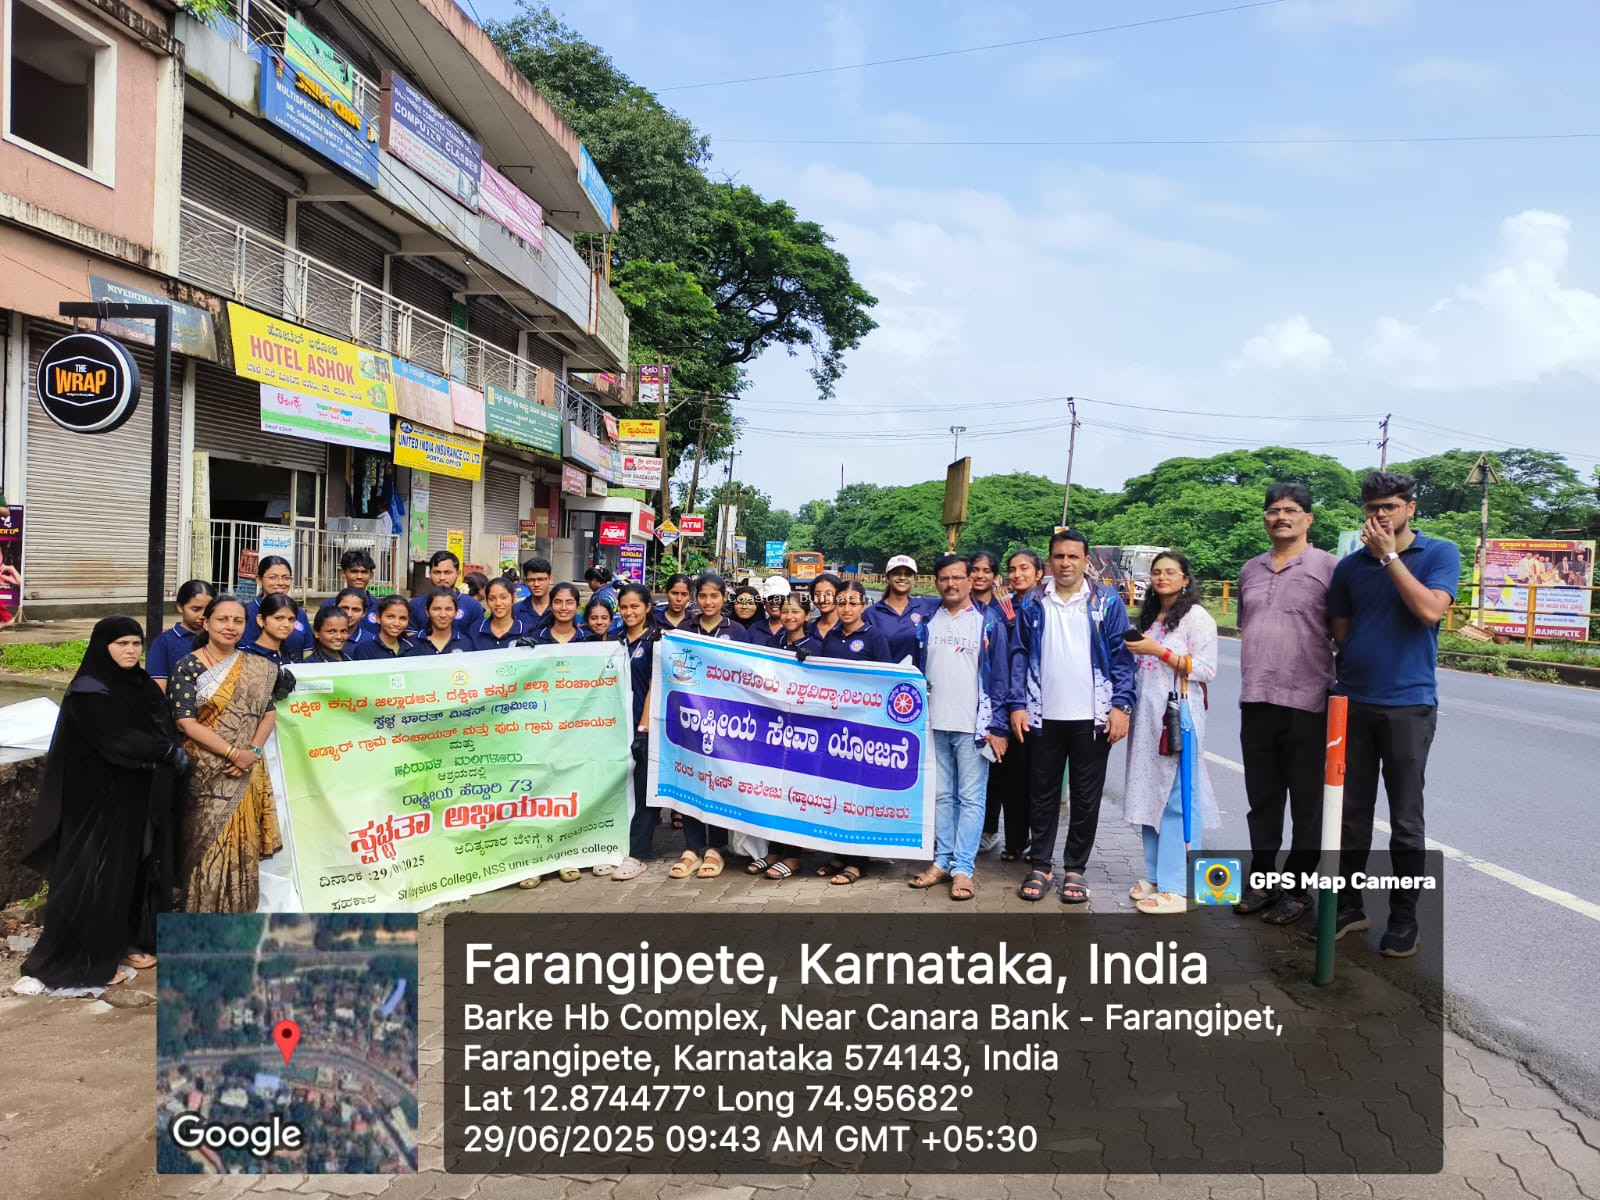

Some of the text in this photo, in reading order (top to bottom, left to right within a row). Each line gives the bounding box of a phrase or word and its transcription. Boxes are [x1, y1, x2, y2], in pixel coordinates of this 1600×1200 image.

[394, 101, 441, 144] COMPUTER
[444, 142, 478, 174] CLASSES
[75, 364, 87, 373] THE
[249, 335, 355, 386] HOTEL ASHOK
[55, 366, 106, 395] WRAP
[398, 434, 419, 449] UNITED
[420, 439, 434, 453] INDIA
[435, 444, 462, 460] INSURANCE
[426, 454, 462, 467] PORTAL OFFICE
[681, 521, 701, 529] ATM
[928, 636, 978, 649] THENTIC
[290, 701, 320, 718] ದಕ್ಷಿಣ
[328, 697, 368, 713] ಕನ್ನಡ
[446, 688, 478, 704] ದಕ್ಷಿಣ
[484, 682, 517, 699] ಕನ್ನಡ
[523, 677, 549, 693] ಜಿಲ್ಲಾ
[555, 675, 618, 689] ಪಂಚಾಯತ್
[706, 664, 780, 692] ಮಂಗಳೂರು
[786, 682, 883, 710] ವಿಶ್ವವಿದ್ಯಾನಿಲಯ
[401, 711, 443, 723] ಭಾರತ್
[449, 705, 485, 719] ಮಿಷನ್
[308, 716, 617, 762] ಅಡ್ಯಾರ್ ಗ್ರಾಮ ಪಂಚಾಯತ್ ಮತ್ತು ಪುದು ಗ್ರಾಮ ಪಂಚಾಯತ್
[450, 739, 476, 752] ಮತ್ತು
[679, 705, 909, 770] ರಾಷ್ಟ್ರೀಯ ಸೇವಾ ಯೋಜನೆ
[454, 752, 522, 767] ಮಂಗಳೂರು
[459, 781, 502, 801] ಹೆದ್ದಾರಿ
[508, 779, 533, 792] 73
[674, 761, 694, 777] ಸಂತ
[738, 781, 782, 799] ಕಾಲೇಜು
[788, 786, 837, 815] (ಸ್ವಾಯತ್ತ)
[843, 801, 910, 819] ಮಂಗಳೂರು
[444, 792, 578, 830] ಅಭಿಯಾನ
[455, 836, 508, 856] ಆದಿತ್ಯವಾರ
[547, 835, 553, 843] 8
[559, 819, 614, 842] ಗಂಟೆಯಿಂದ
[440, 869, 481, 888] College,
[482, 862, 506, 878] NSS
[509, 859, 529, 872] unit
[547, 848, 579, 861] Agnes
[581, 843, 618, 855] college
[319, 871, 363, 888] ದಿನಾಂಕ
[331, 894, 376, 911] ಸಹಕಾರ
